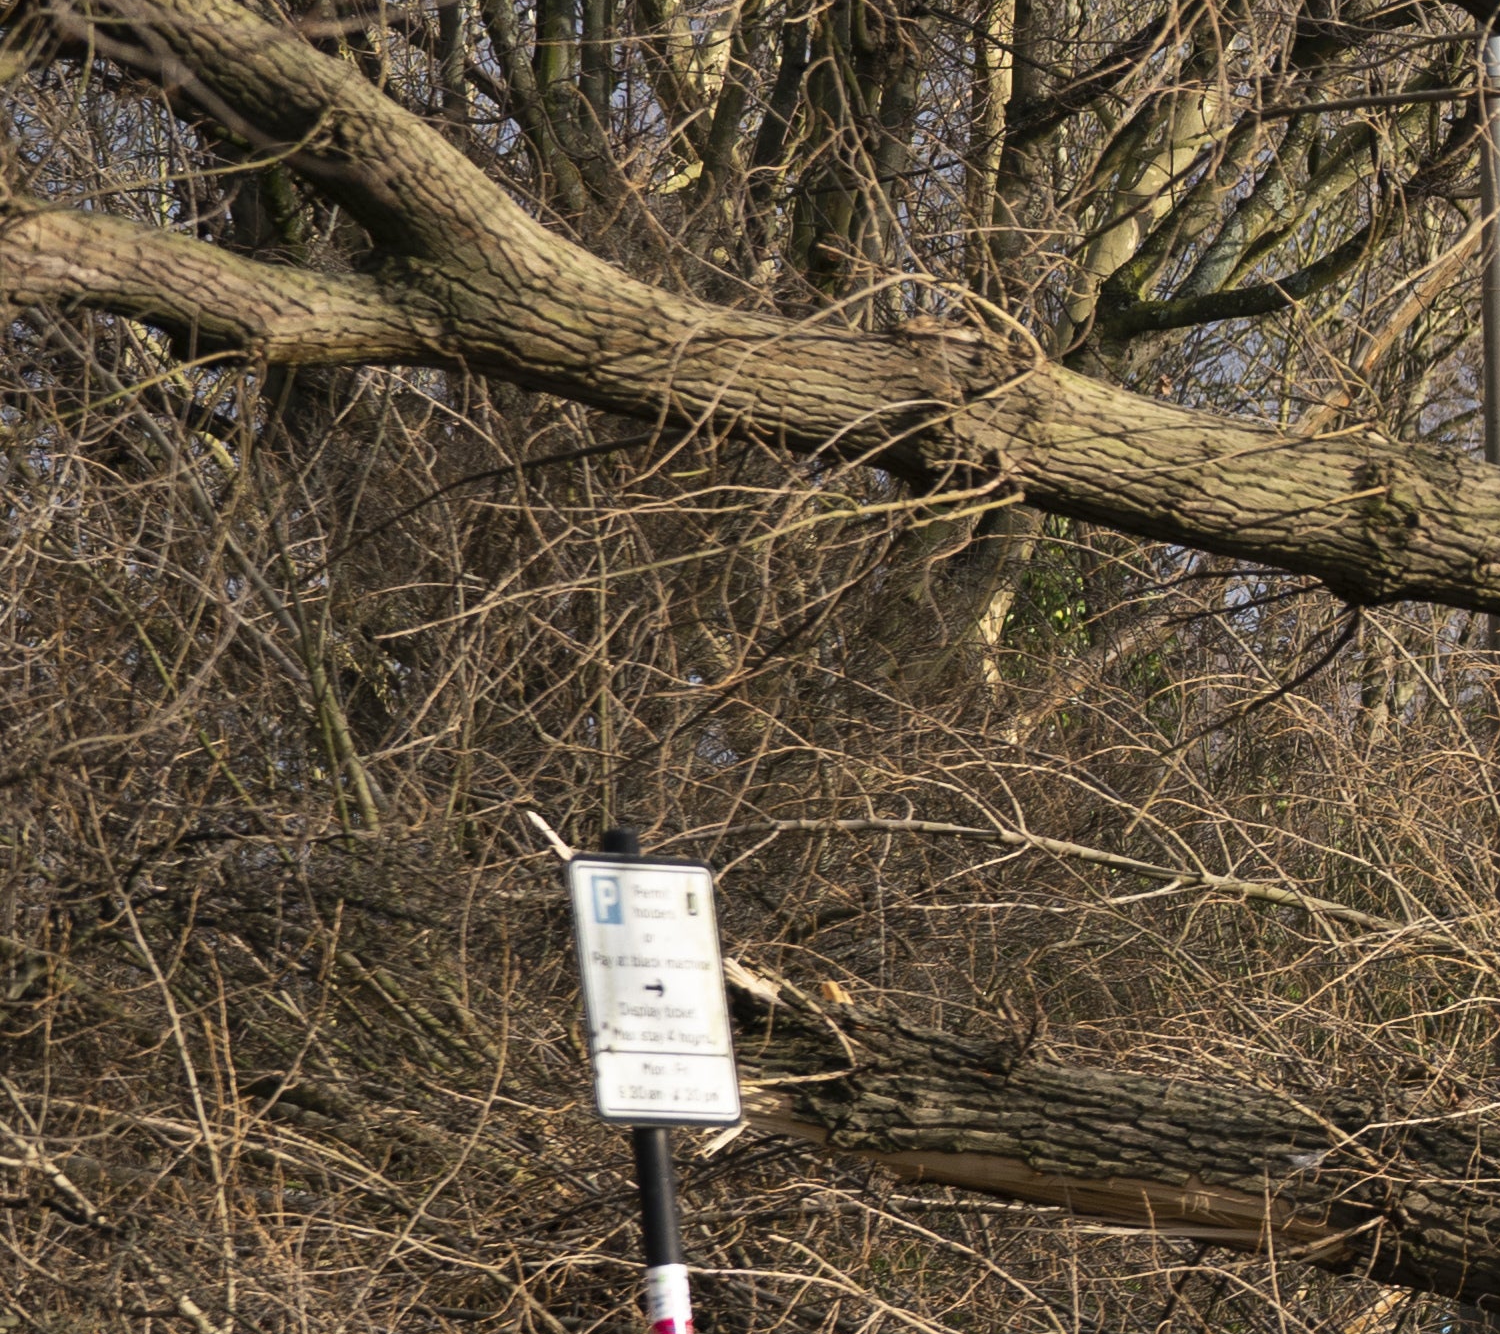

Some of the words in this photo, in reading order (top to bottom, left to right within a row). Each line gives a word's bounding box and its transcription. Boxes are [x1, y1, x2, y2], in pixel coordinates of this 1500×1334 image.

[597, 879, 619, 921] P
[593, 951, 615, 970] Pay
[616, 953, 630, 967] at
[632, 953, 661, 968] black
[665, 958, 711, 971] machine
[617, 1001, 660, 1020] Display
